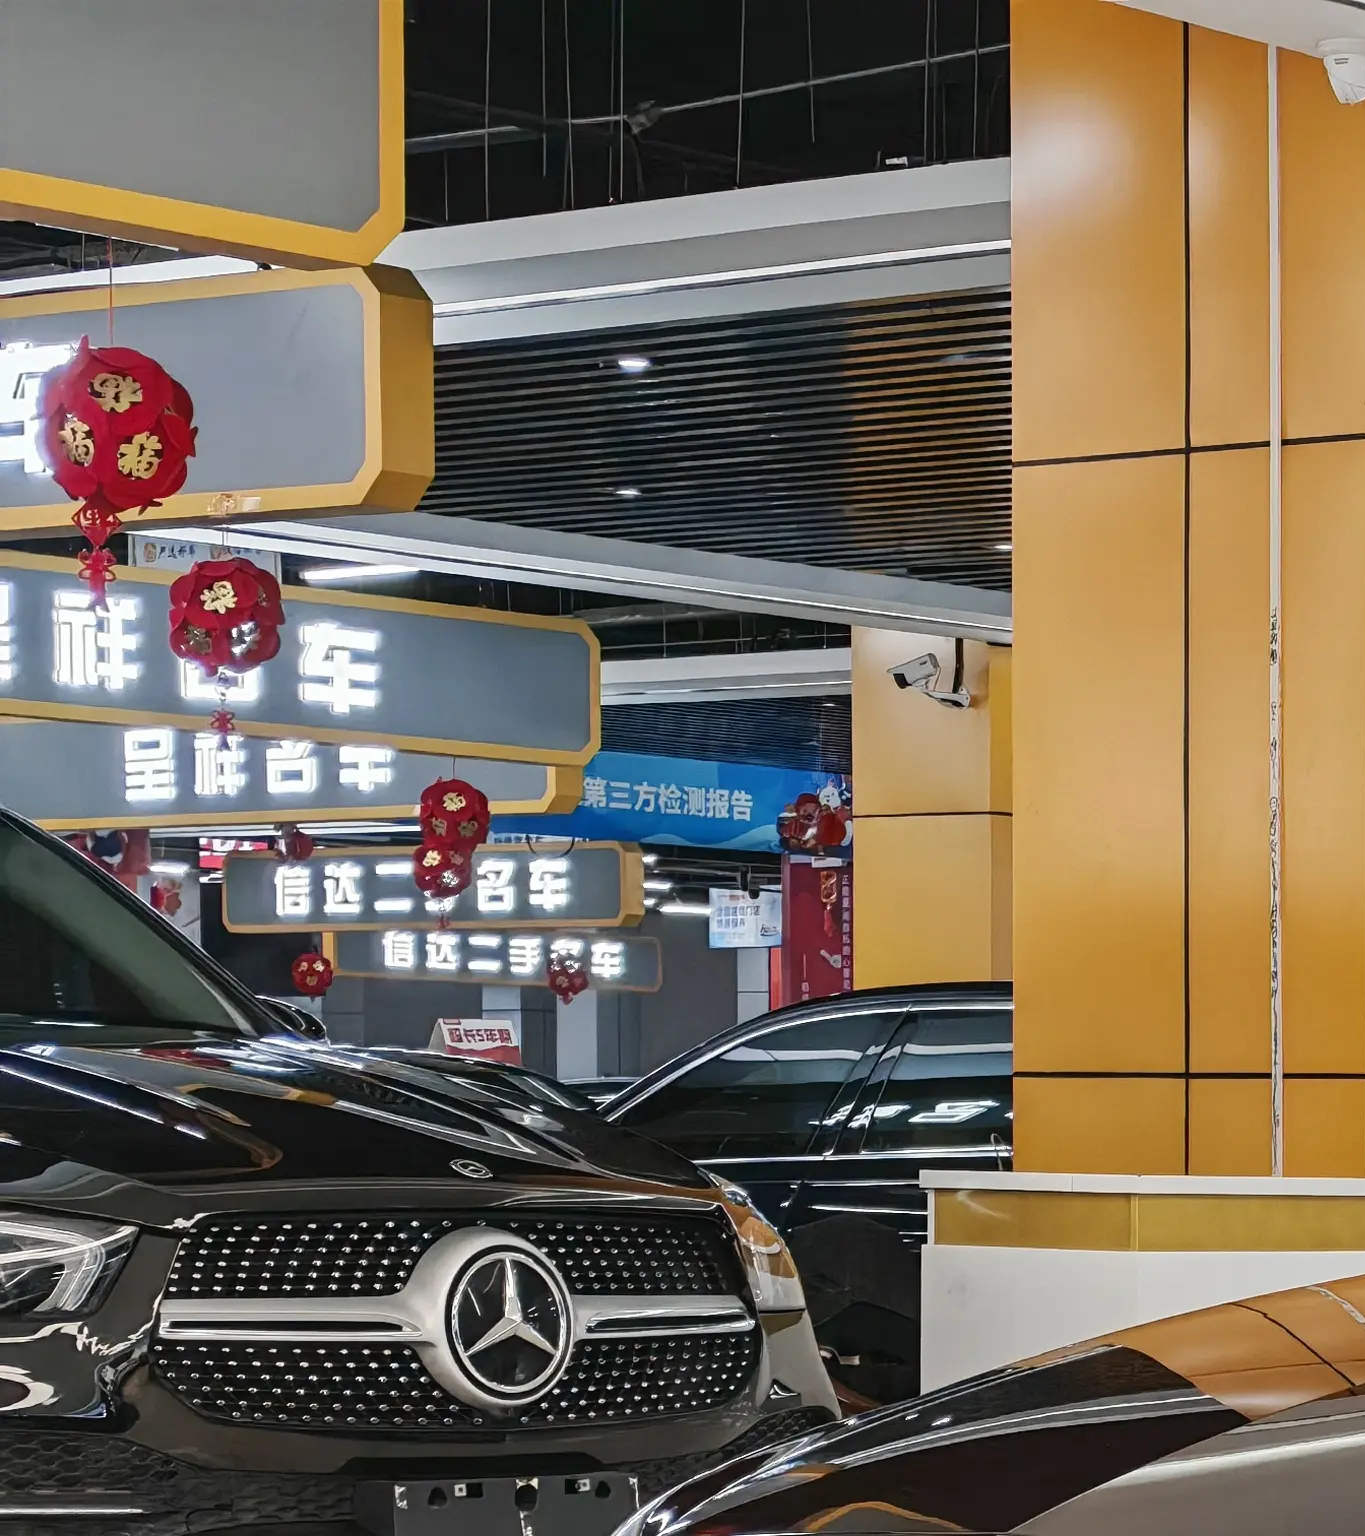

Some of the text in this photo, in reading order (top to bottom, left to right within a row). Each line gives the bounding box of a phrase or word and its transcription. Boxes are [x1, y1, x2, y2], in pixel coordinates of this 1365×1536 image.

[0, 582, 379, 714] 祥车
[578, 777, 753, 822] 第三方检测报告
[274, 858, 569, 917] 信达二名车
